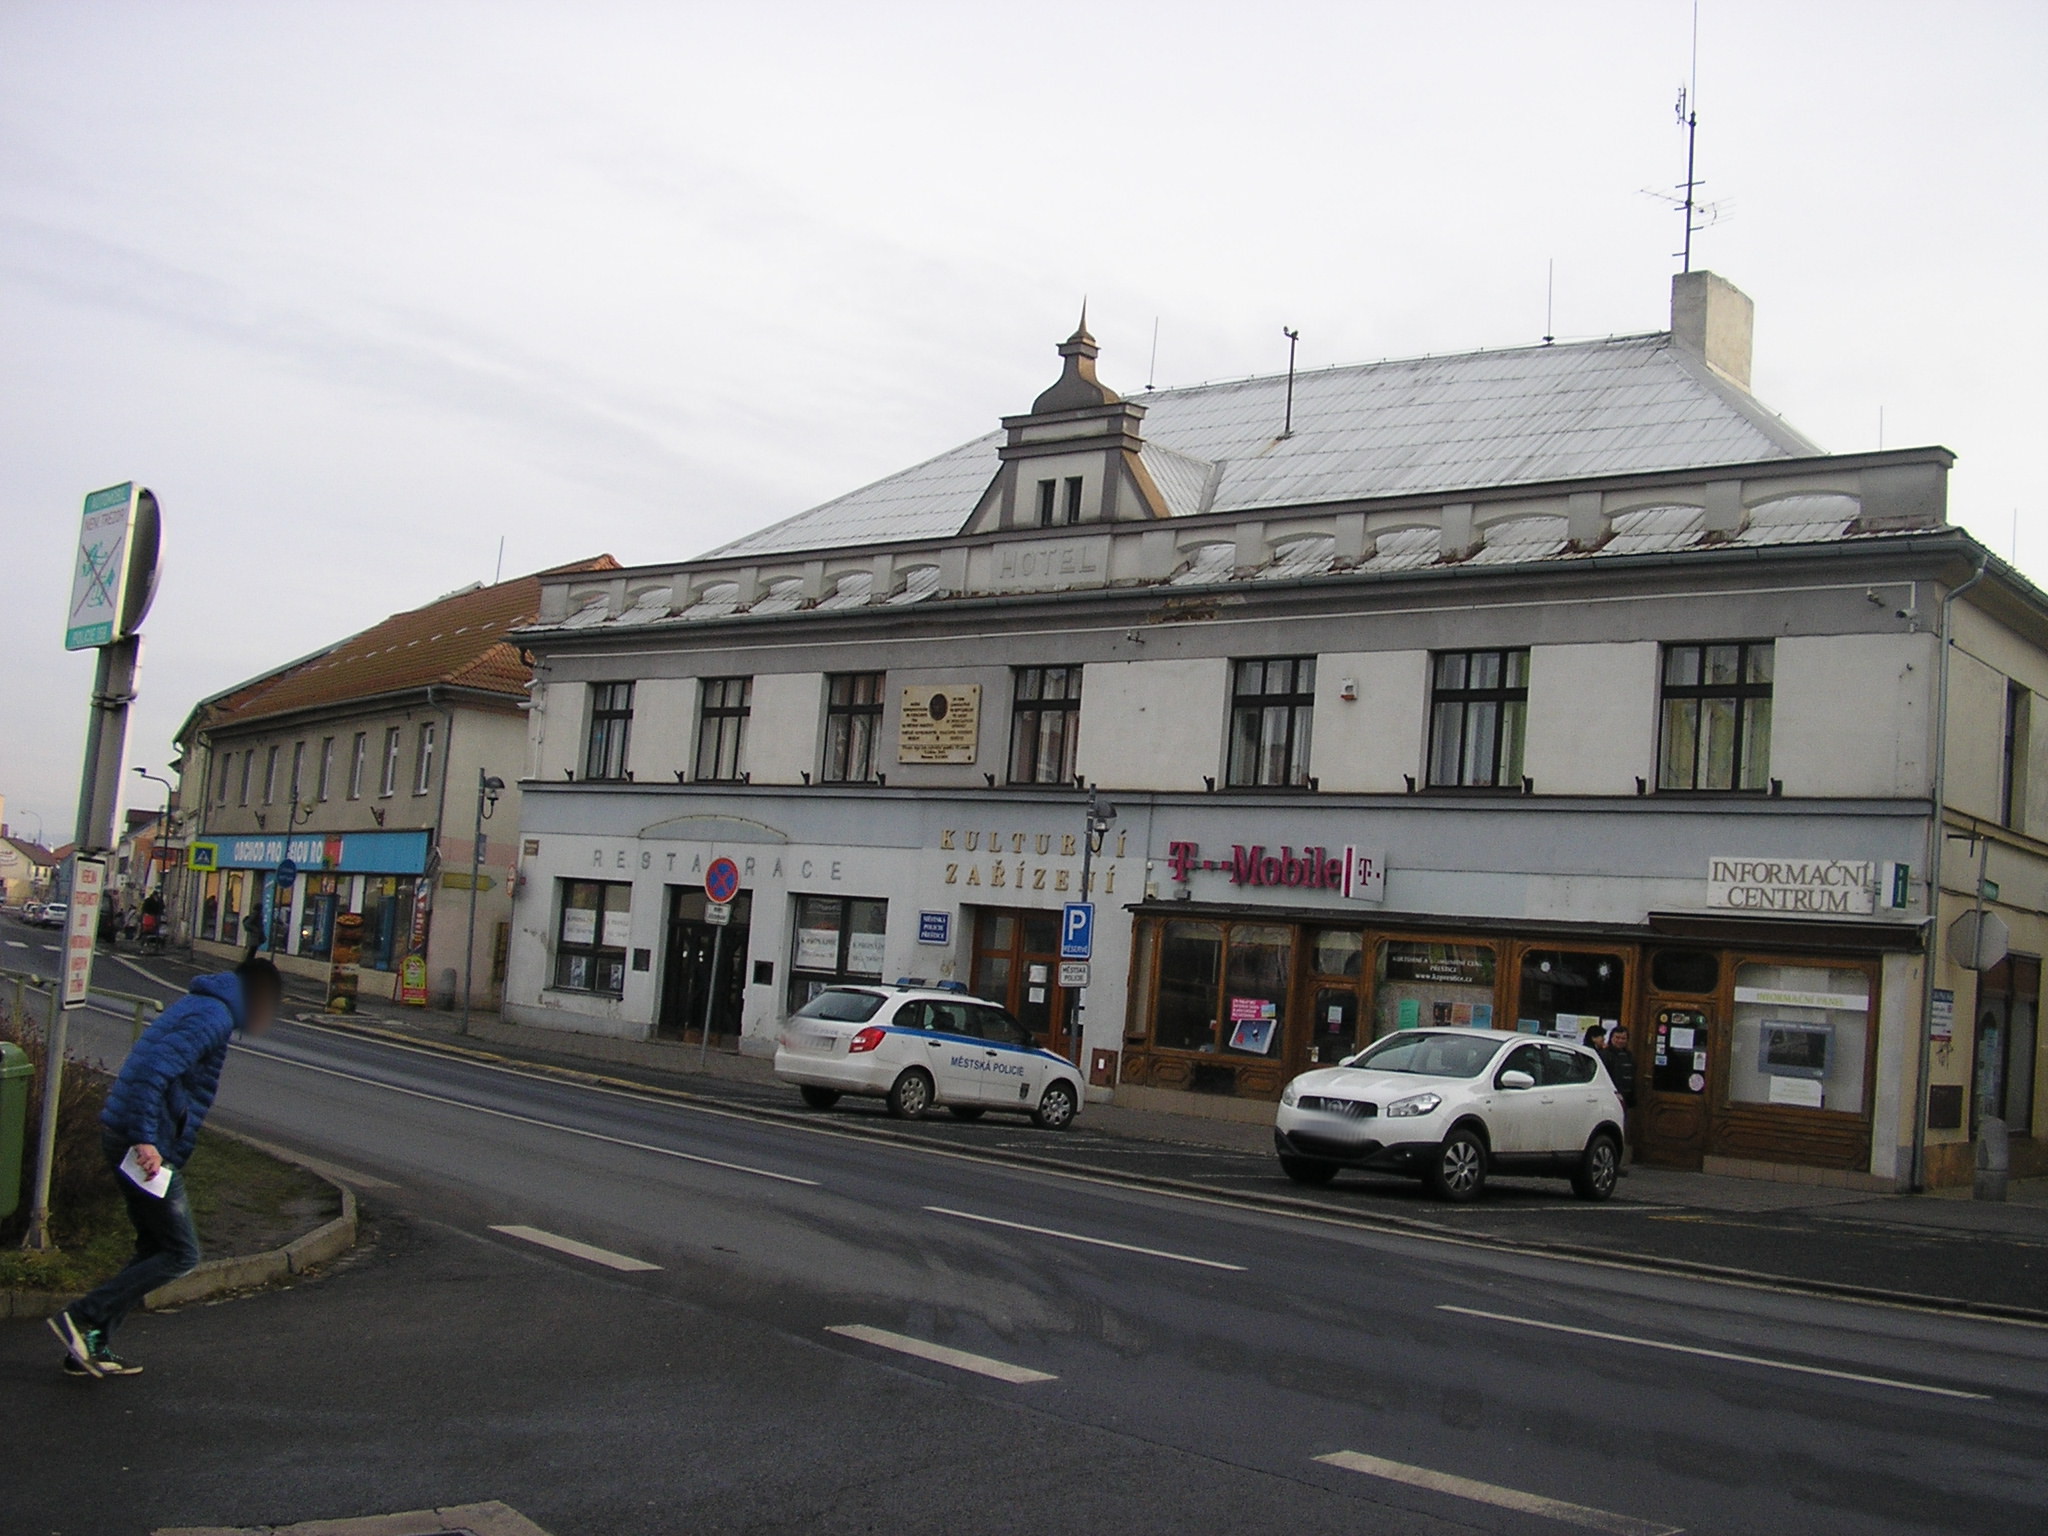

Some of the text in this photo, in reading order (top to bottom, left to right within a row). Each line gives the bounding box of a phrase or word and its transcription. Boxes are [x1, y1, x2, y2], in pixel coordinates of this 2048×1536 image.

[1000, 545, 1097, 579] HOTEL
[592, 850, 842, 881] RESTARACE
[1712, 860, 1871, 887] INFORMAČNÍ
[1728, 886, 1850, 912] CENTRUM
[1068, 910, 1087, 941] P
[951, 1056, 1024, 1077] MĚSTSKÁ POLICIE
